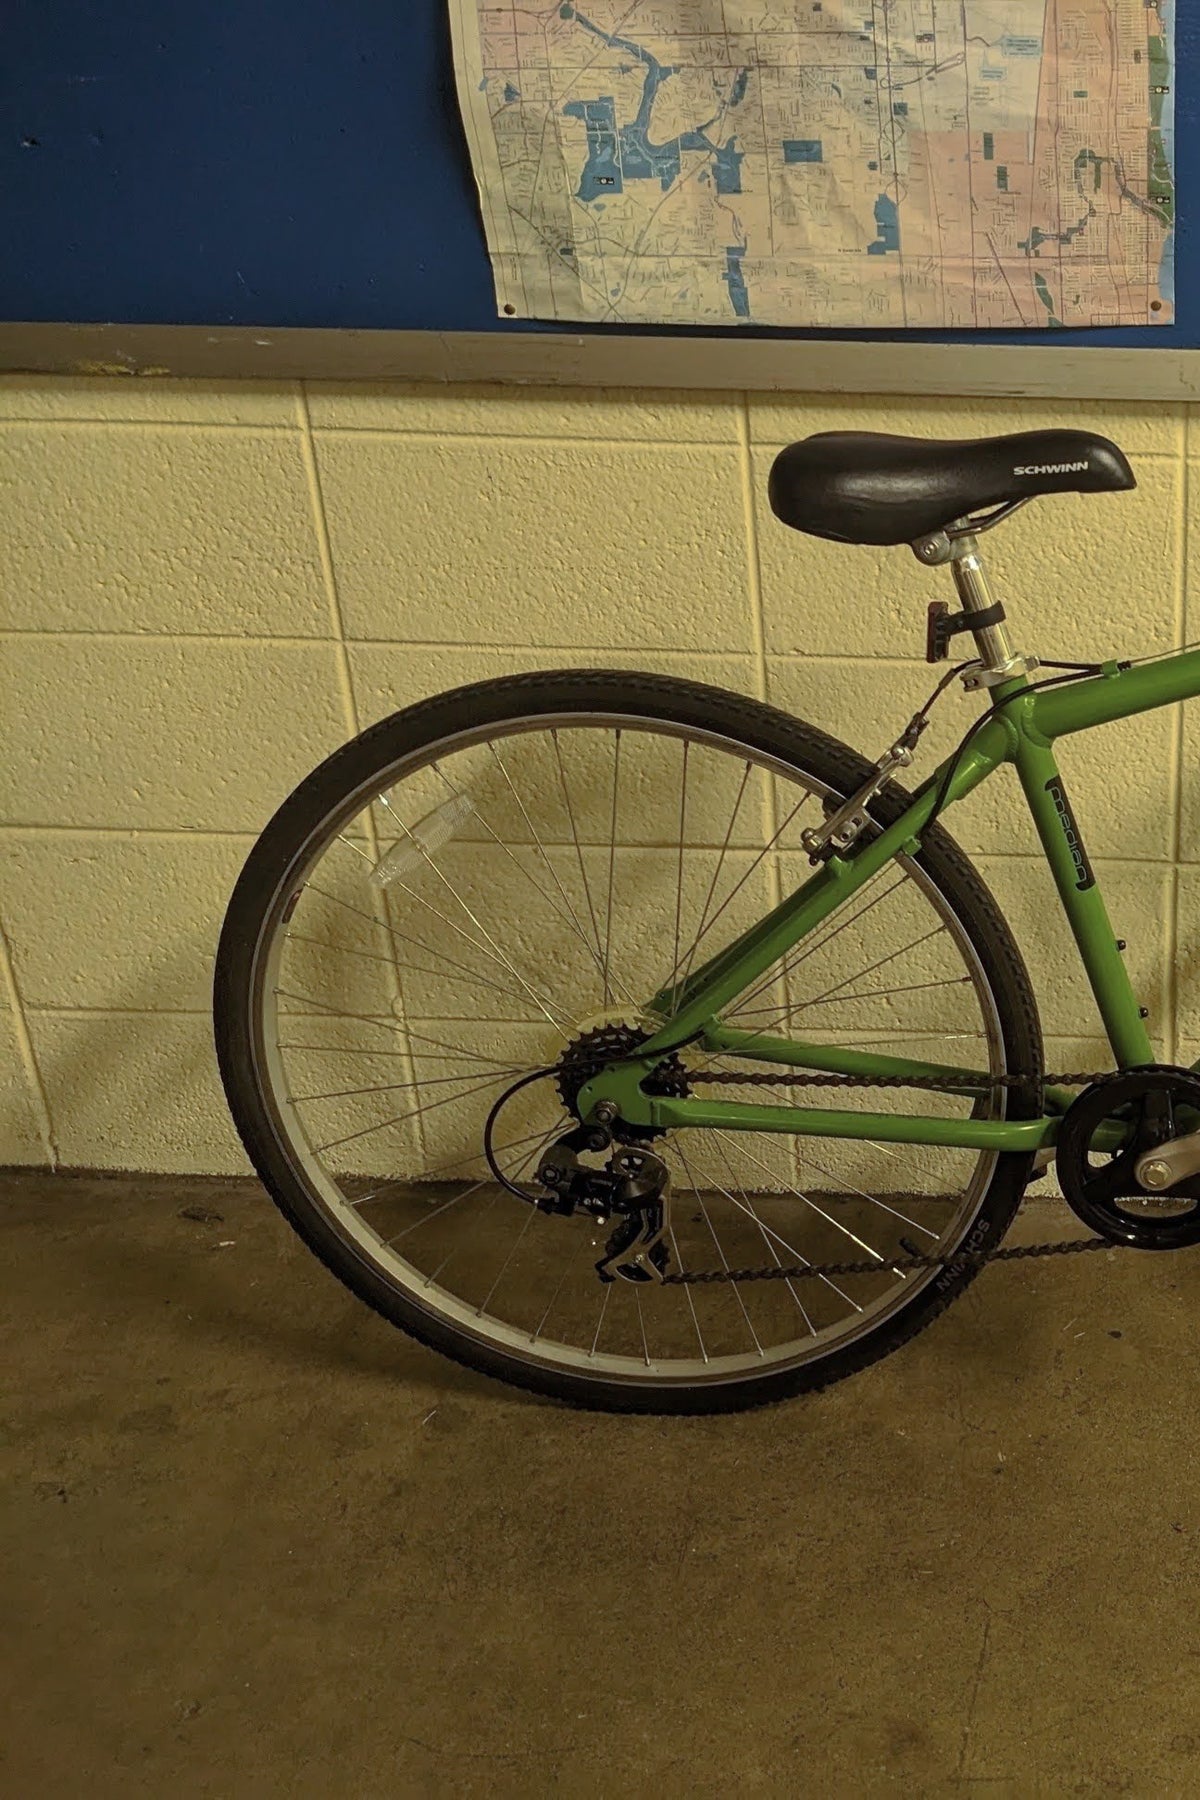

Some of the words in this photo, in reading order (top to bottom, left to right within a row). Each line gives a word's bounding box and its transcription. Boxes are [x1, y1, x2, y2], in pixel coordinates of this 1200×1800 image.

[1013, 461, 1089, 476] SCHWINN
[1048, 784, 1088, 884] median
[936, 1219, 991, 1292] SCHINN
